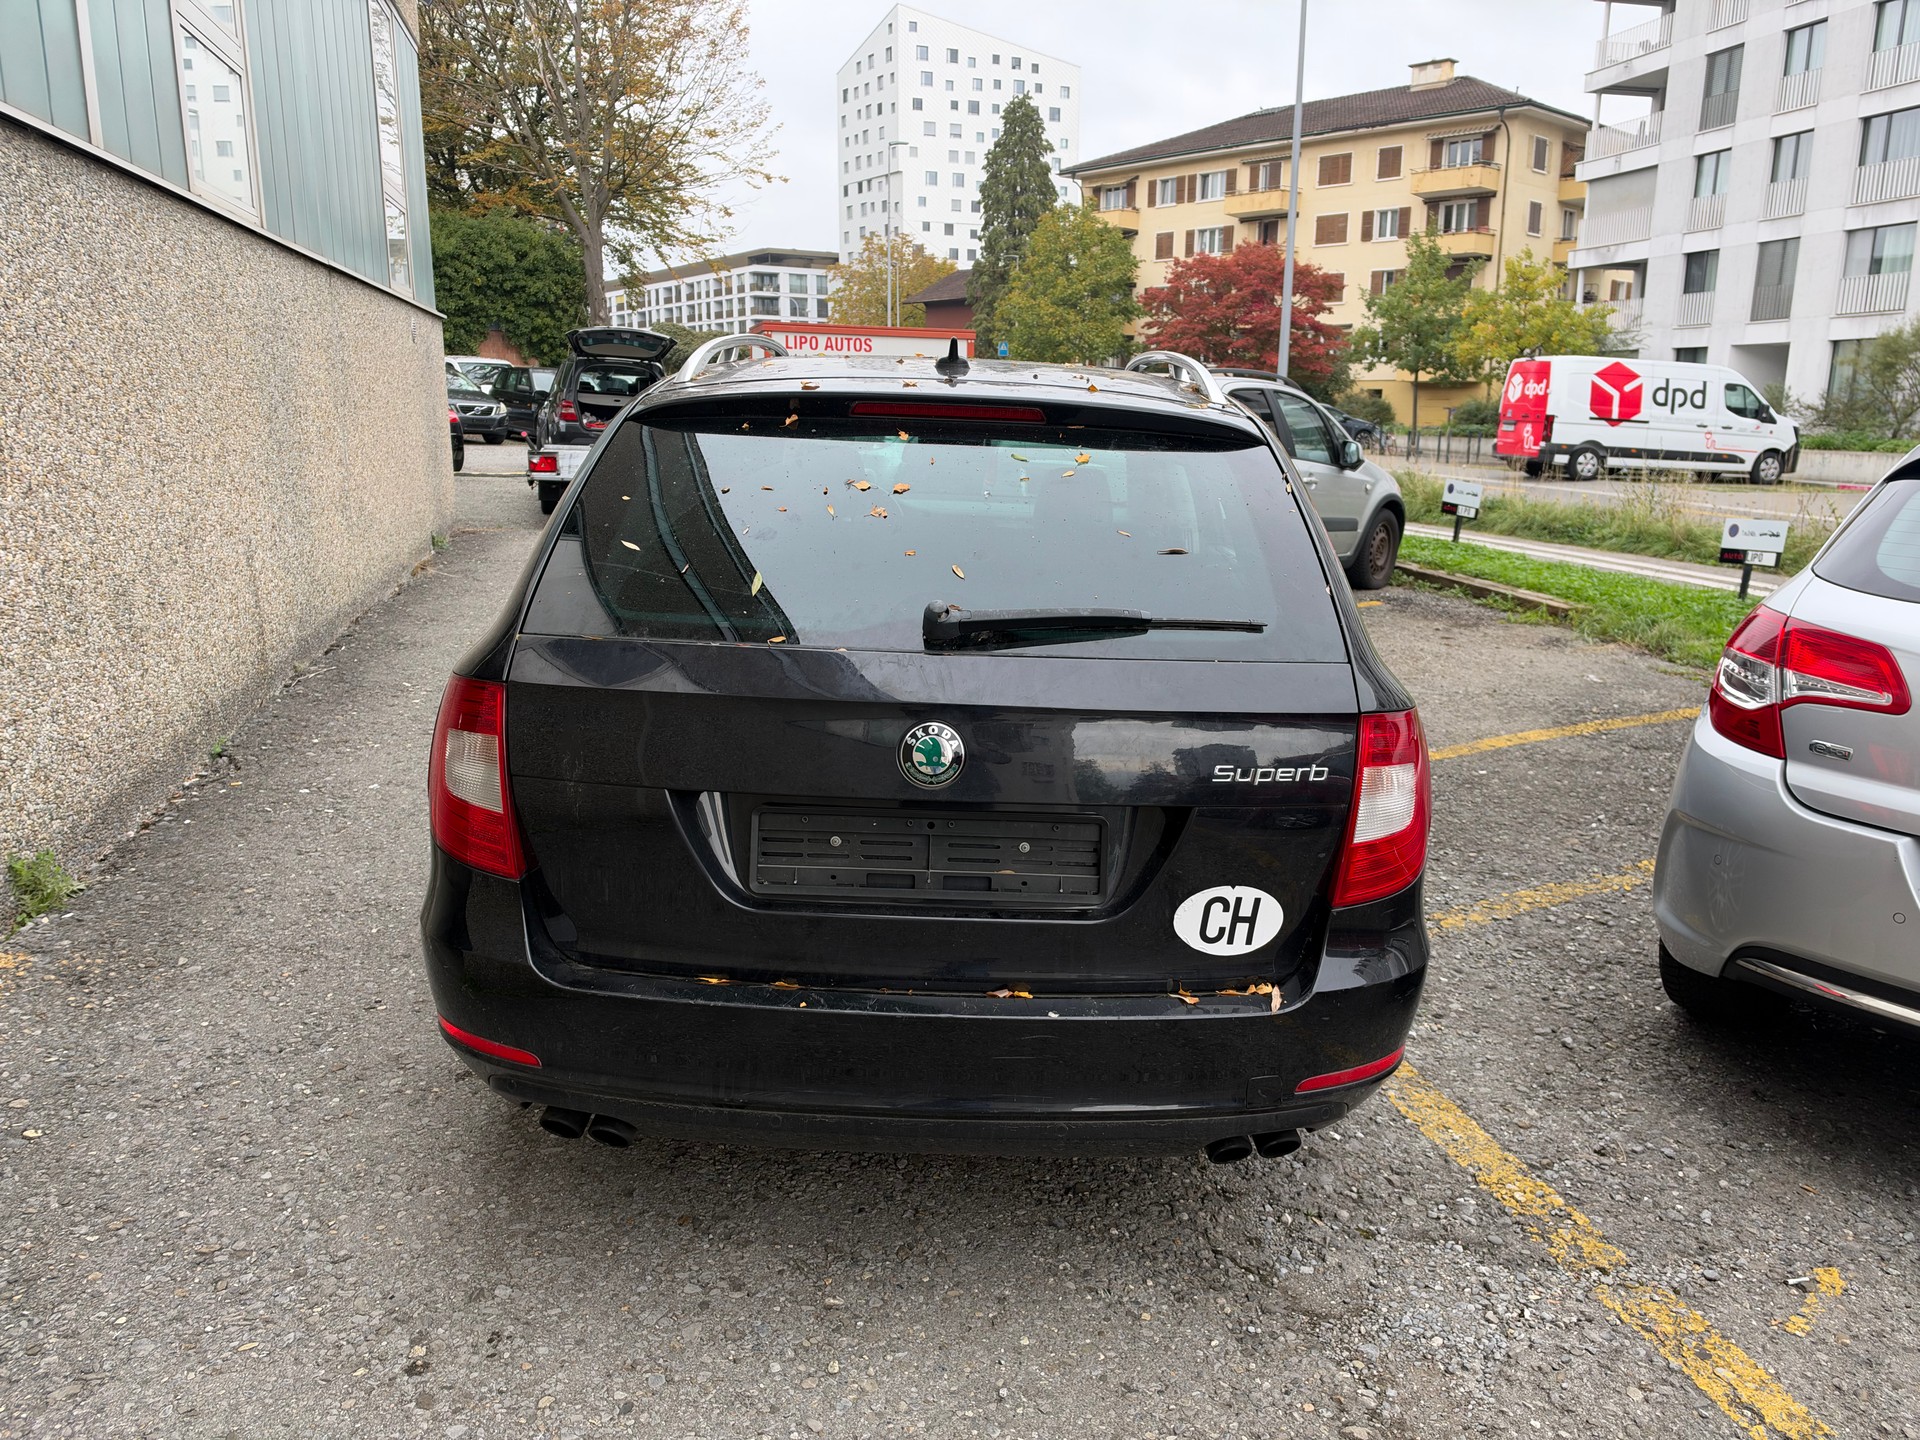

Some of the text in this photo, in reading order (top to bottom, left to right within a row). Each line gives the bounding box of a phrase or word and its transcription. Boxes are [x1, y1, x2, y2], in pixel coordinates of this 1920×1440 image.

[785, 335, 873, 352] LIPO AUTOS
[1524, 378, 1547, 399] dpd
[1652, 378, 1707, 414] dpd
[1745, 551, 1764, 562] LIPO
[1212, 764, 1329, 785] Superb
[1199, 895, 1262, 946] CH
